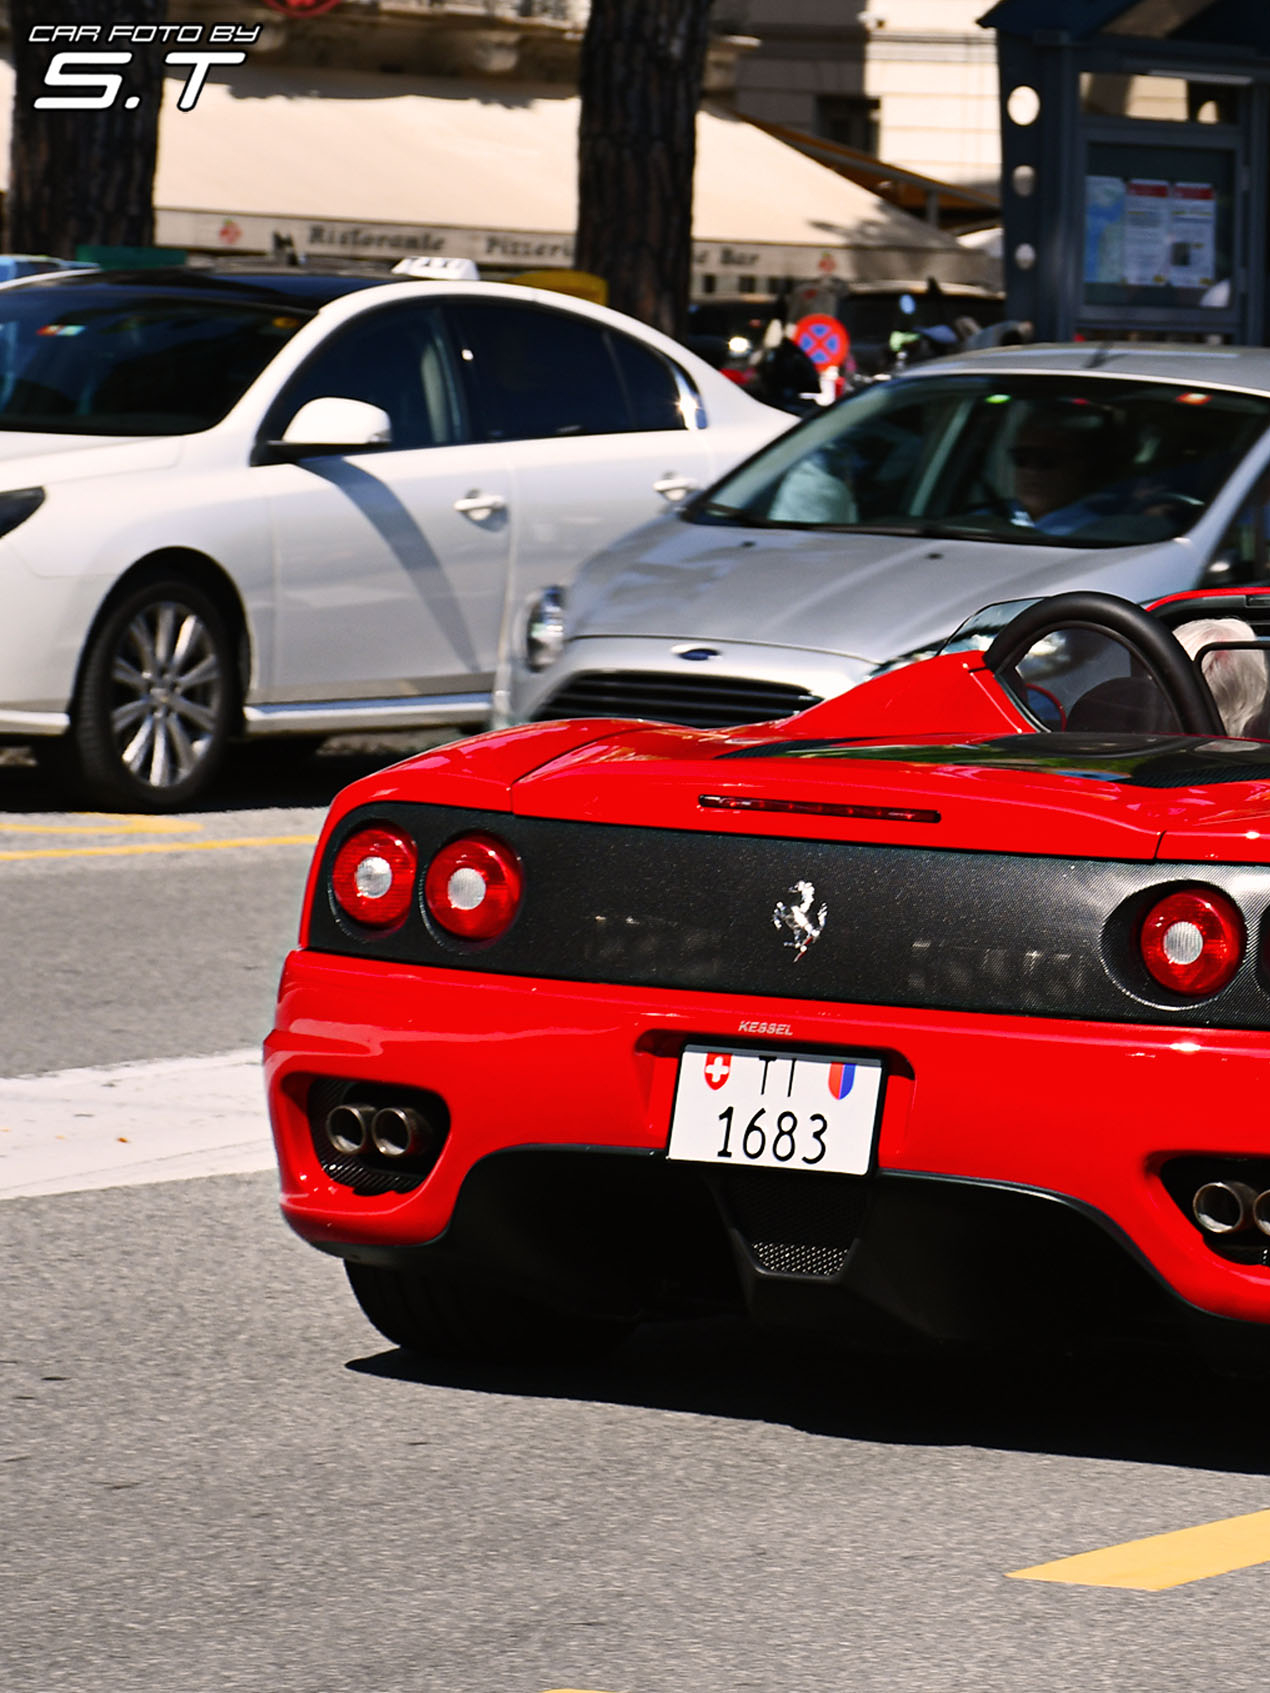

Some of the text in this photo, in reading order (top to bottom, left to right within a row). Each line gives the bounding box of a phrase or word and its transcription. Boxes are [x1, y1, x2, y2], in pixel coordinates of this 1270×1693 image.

[486, 236, 572, 257] Pizzeri
[738, 1020, 794, 1036] KESSEL
[758, 1055, 798, 1098] TI
[716, 1105, 829, 1165] 1683
